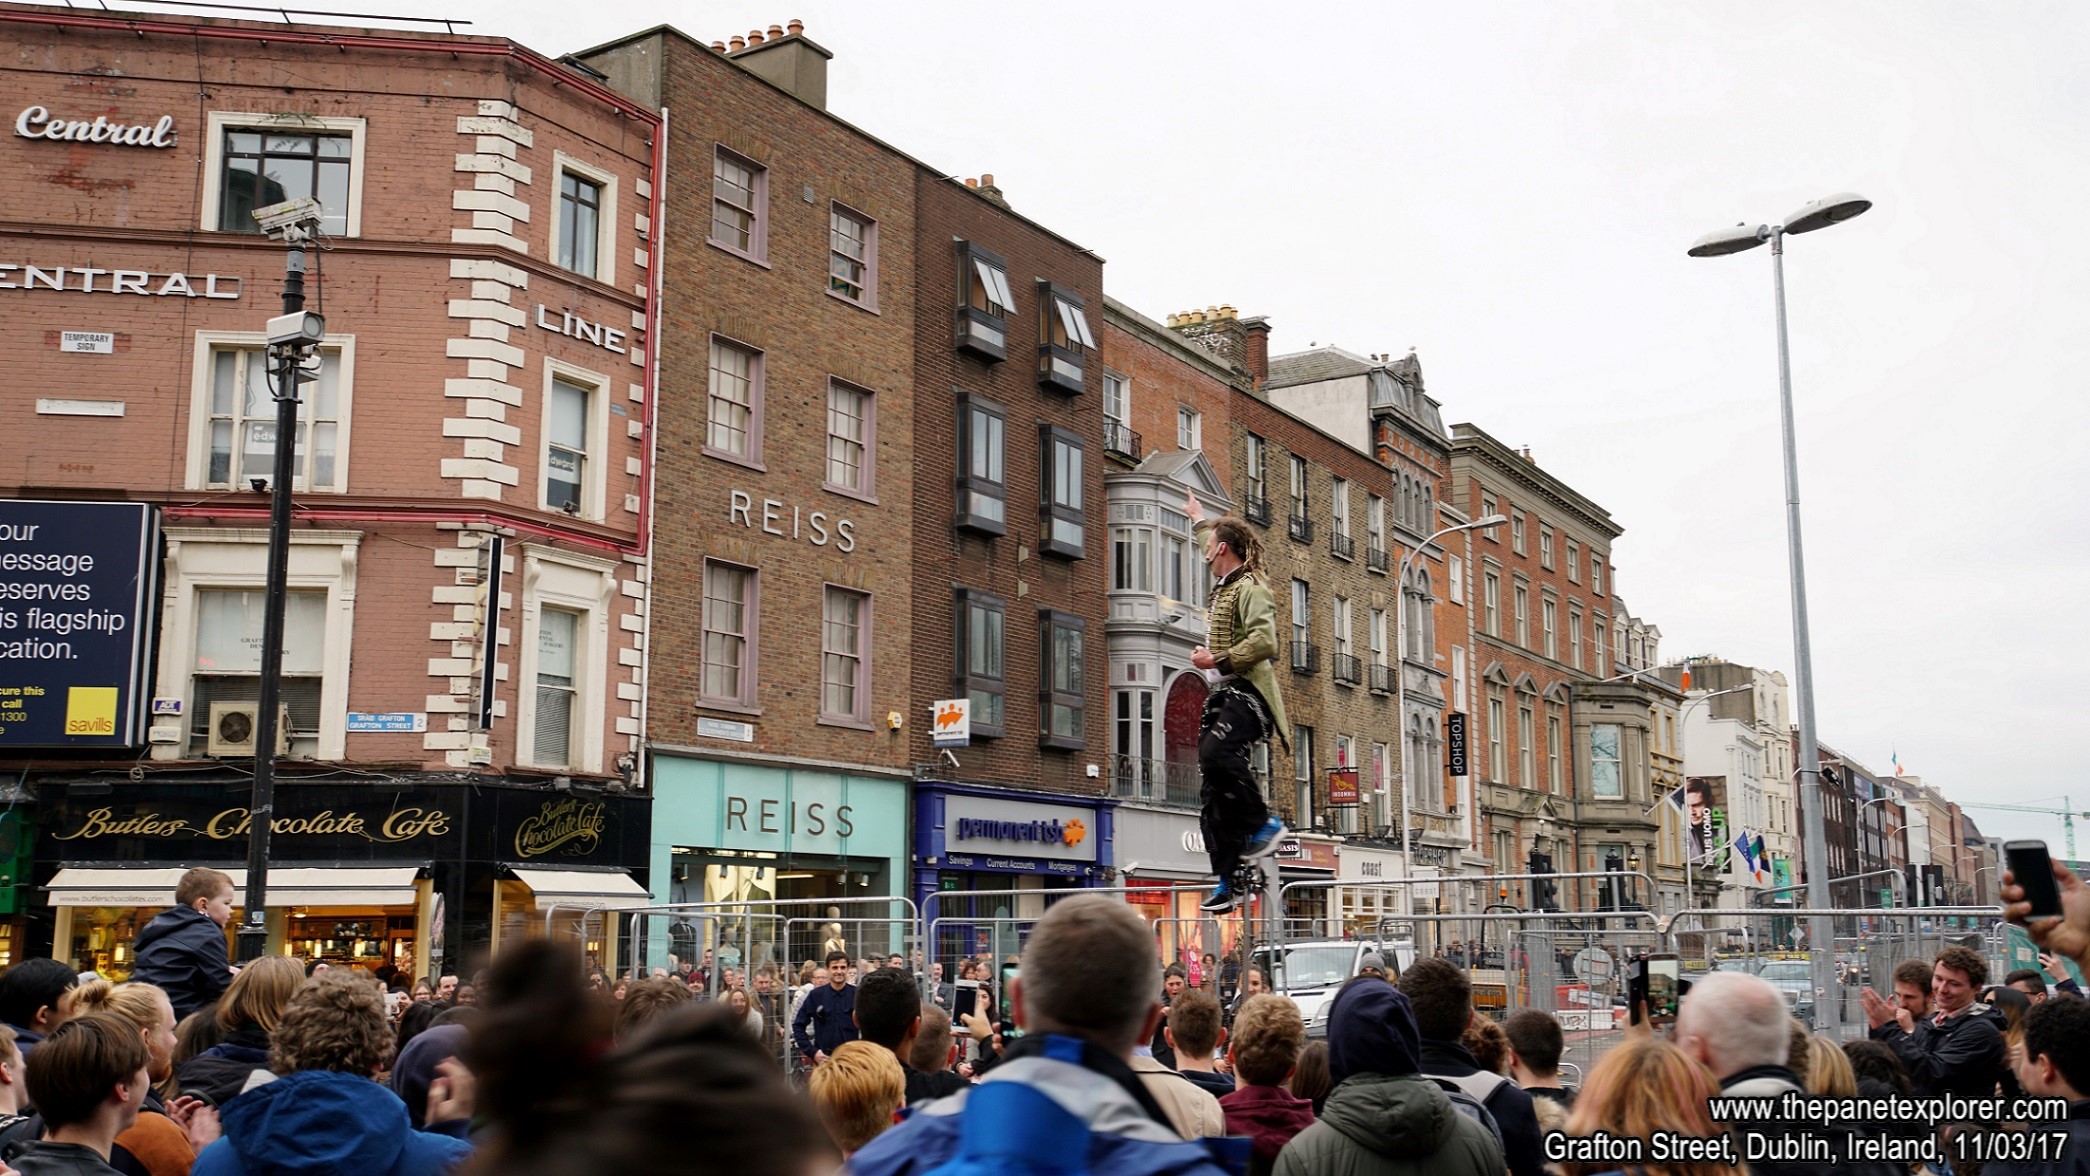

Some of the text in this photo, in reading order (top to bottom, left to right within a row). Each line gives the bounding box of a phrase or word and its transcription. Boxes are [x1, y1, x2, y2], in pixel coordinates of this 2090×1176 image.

[16, 106, 173, 148] Central
[64, 333, 110, 343] TEMPORARY
[537, 303, 626, 354] LINE
[76, 342, 96, 351] SIGN
[730, 490, 855, 552] REISS
[27, 608, 125, 635] flagship
[23, 686, 45, 696] this
[1, 699, 22, 708] call
[0, 711, 27, 721] 1300
[69, 717, 112, 732] savills
[417, 718, 423, 728] 2
[1451, 716, 1463, 773] TOPSHOP
[540, 799, 577, 826] Butlers
[727, 796, 853, 838] REISS
[1703, 807, 1712, 837] UOMO
[1711, 807, 1727, 829] UP
[51, 806, 451, 842] Butlers Chcolate Café
[957, 818, 1064, 843] permanent tsb
[515, 814, 577, 858] Chocolate
[1279, 844, 1298, 852] ASIS
[1413, 849, 1447, 865] TOPSHOP
[949, 855, 1077, 872] Savings Current Accounts Mortgages
[1361, 861, 1382, 877] coast
